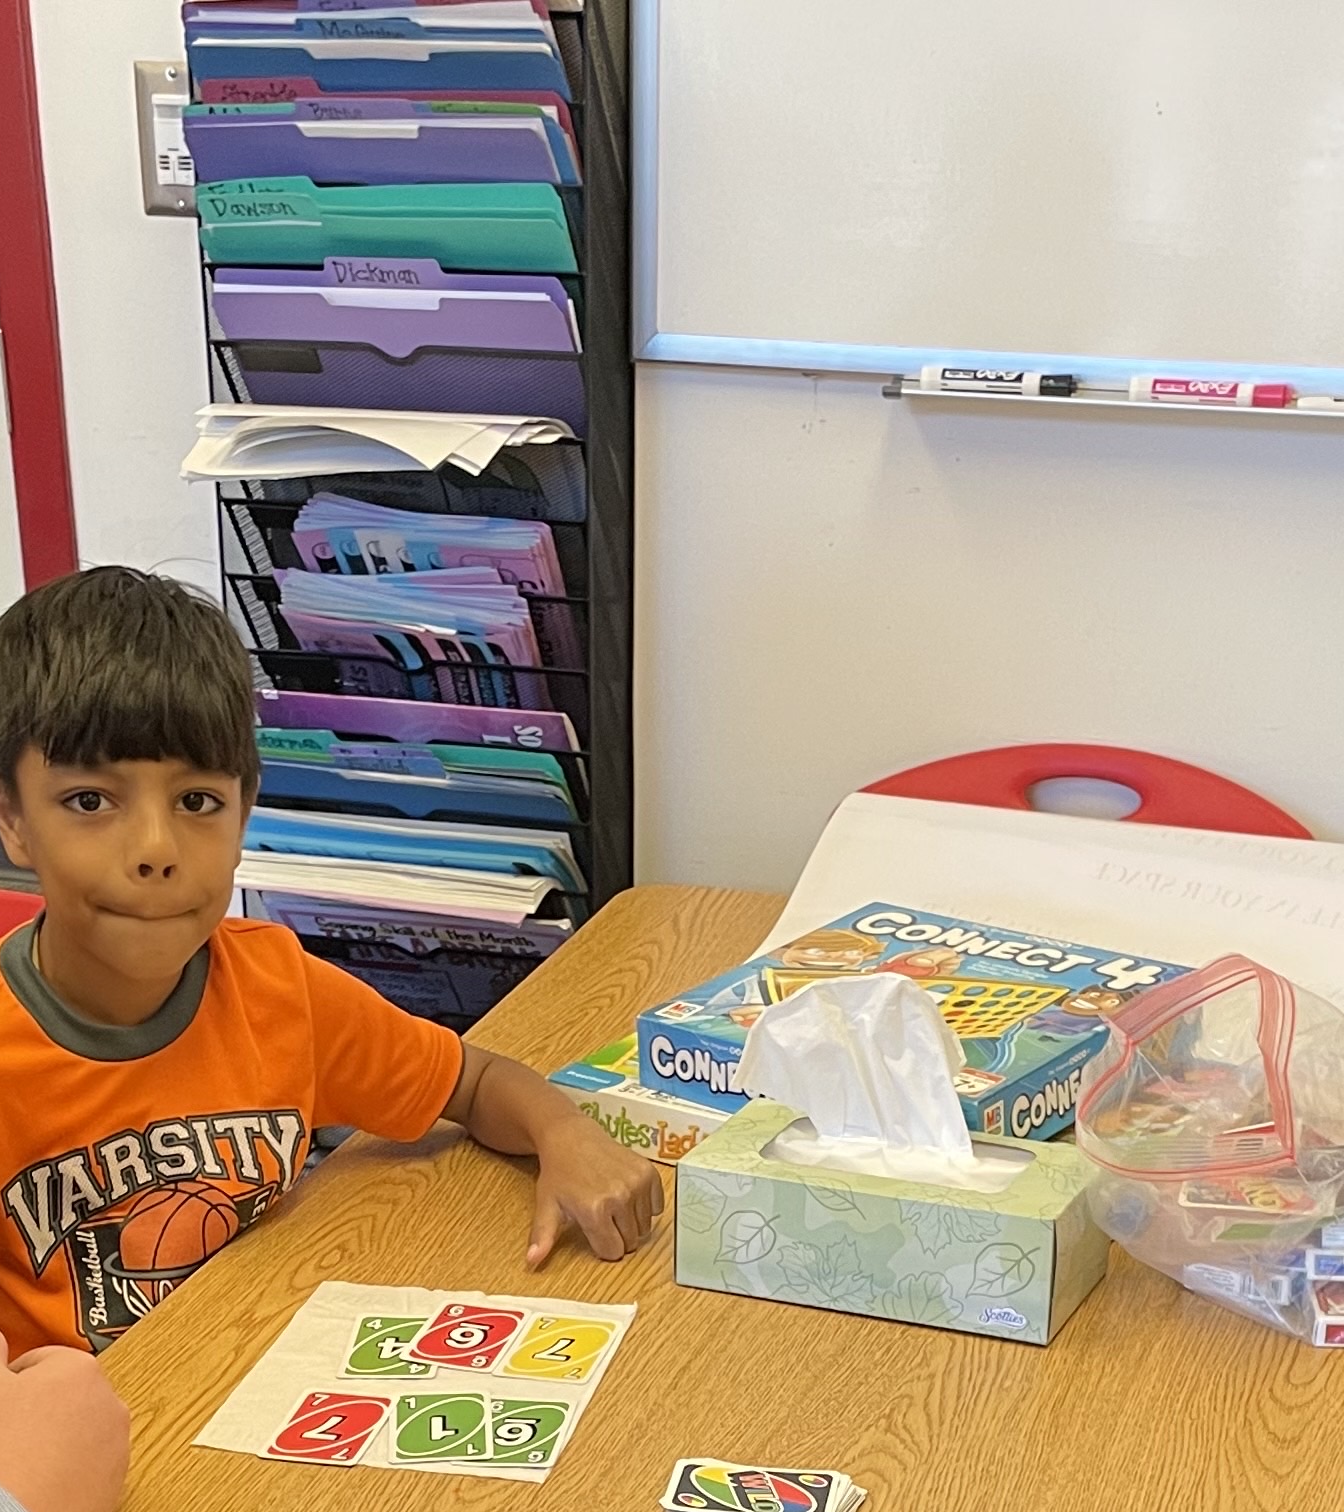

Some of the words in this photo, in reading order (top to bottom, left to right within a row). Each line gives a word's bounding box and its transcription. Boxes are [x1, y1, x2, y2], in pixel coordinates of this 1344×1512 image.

[208, 198, 298, 217] Dawson
[332, 261, 421, 285] Dickman
[446, 929, 475, 942] the
[479, 932, 536, 947] Month
[853, 911, 1096, 973] CONNECT
[1094, 957, 1167, 991] 4
[650, 1034, 764, 1100] CONNE
[1011, 1067, 1083, 1138] CONNE
[657, 1120, 710, 1160] Lad
[1, 1109, 305, 1279] VARSITY
[366, 1318, 382, 1330] 4
[540, 1318, 556, 1329] 7
[532, 1337, 573, 1362] 7
[563, 1367, 582, 1379] 7
[313, 1393, 330, 1406] 7
[405, 1396, 417, 1409] 1
[301, 1415, 342, 1441] 7
[430, 1416, 457, 1441] 1
[331, 1448, 351, 1460] 7
[467, 1443, 480, 1455] 1
